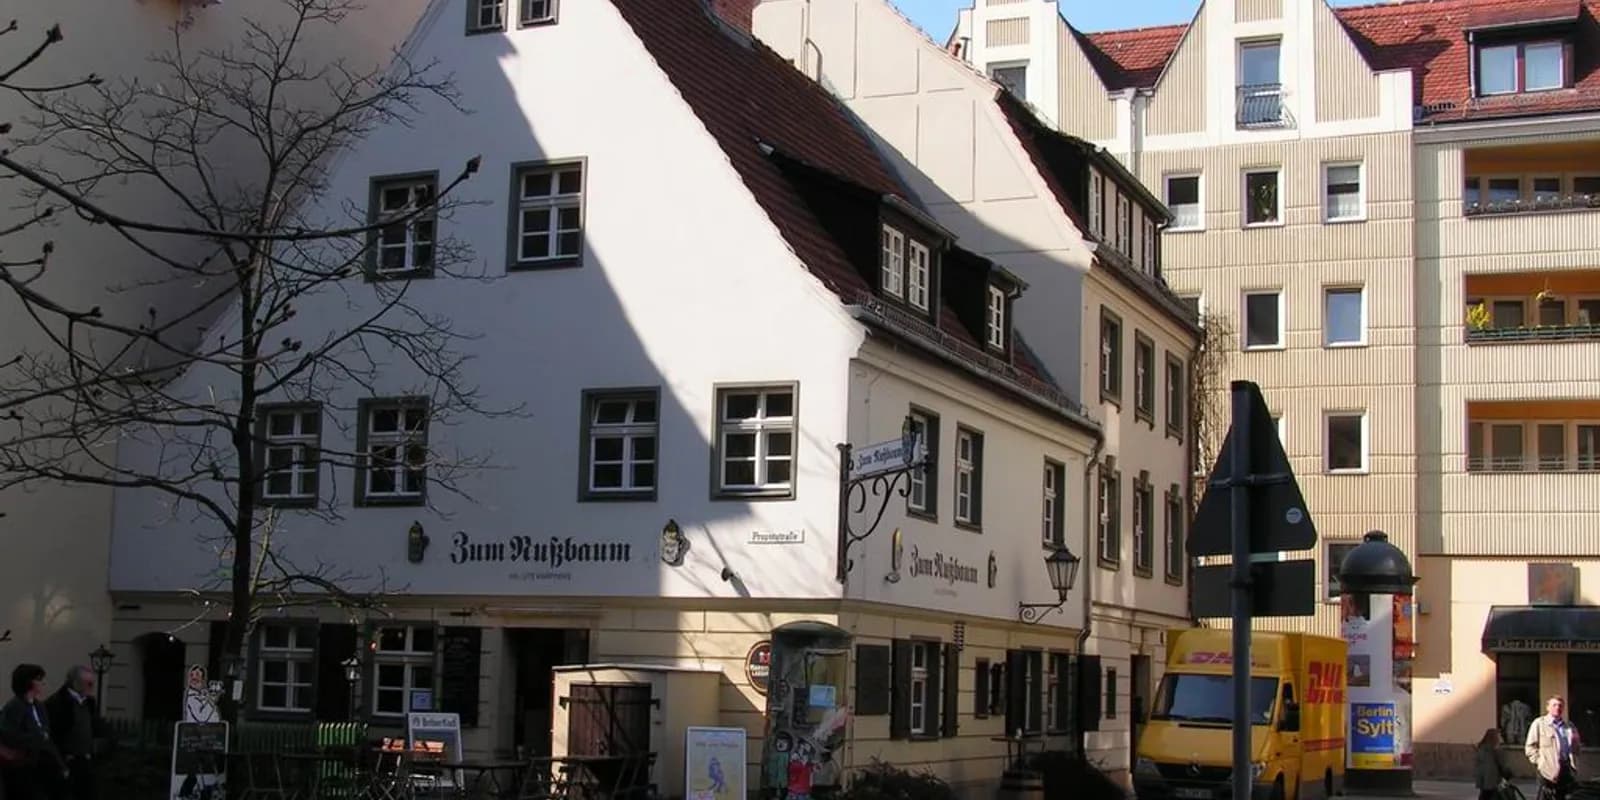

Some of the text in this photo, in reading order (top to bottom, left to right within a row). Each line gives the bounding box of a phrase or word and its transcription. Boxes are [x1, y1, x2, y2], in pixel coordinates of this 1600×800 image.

[450, 530, 631, 568] Zum Nußbaum
[909, 543, 978, 587] Zum Nußbaum
[1306, 661, 1345, 705] DHL
[1358, 705, 1393, 717] Berlin
[1358, 718, 1394, 738] Sylt
